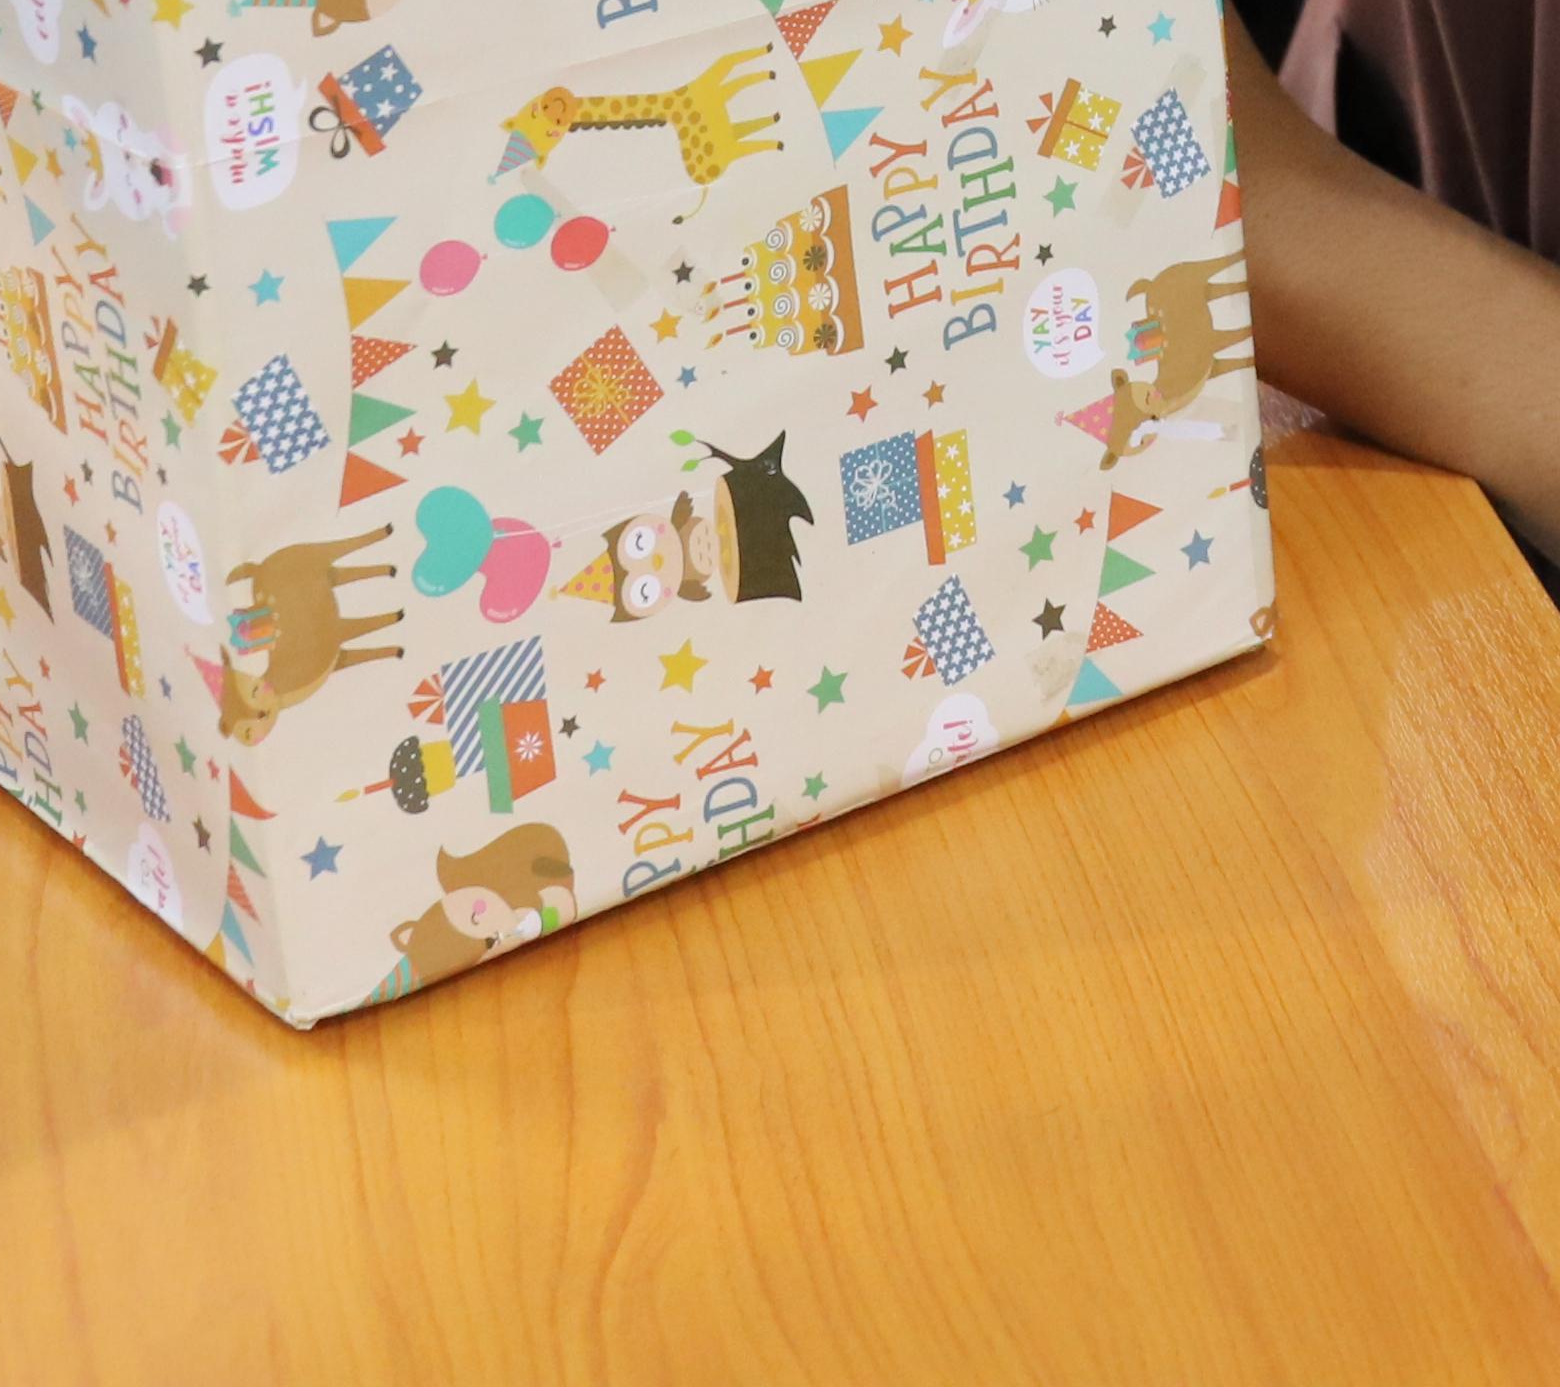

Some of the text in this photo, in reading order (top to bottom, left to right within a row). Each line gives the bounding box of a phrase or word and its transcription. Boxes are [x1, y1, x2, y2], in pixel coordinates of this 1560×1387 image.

[221, 94, 248, 184] make a
[244, 80, 280, 177] WISH!
[869, 132, 948, 319] HAPPY
[919, 67, 1020, 351] BIRTHDAY
[51, 245, 108, 446] HAPPY
[1030, 308, 1053, 354] YAY
[1052, 285, 1073, 329] your
[1071, 298, 1093, 342] DAY
[70, 212, 149, 515] BIRTHDAY
[617, 789, 694, 898] PPY
